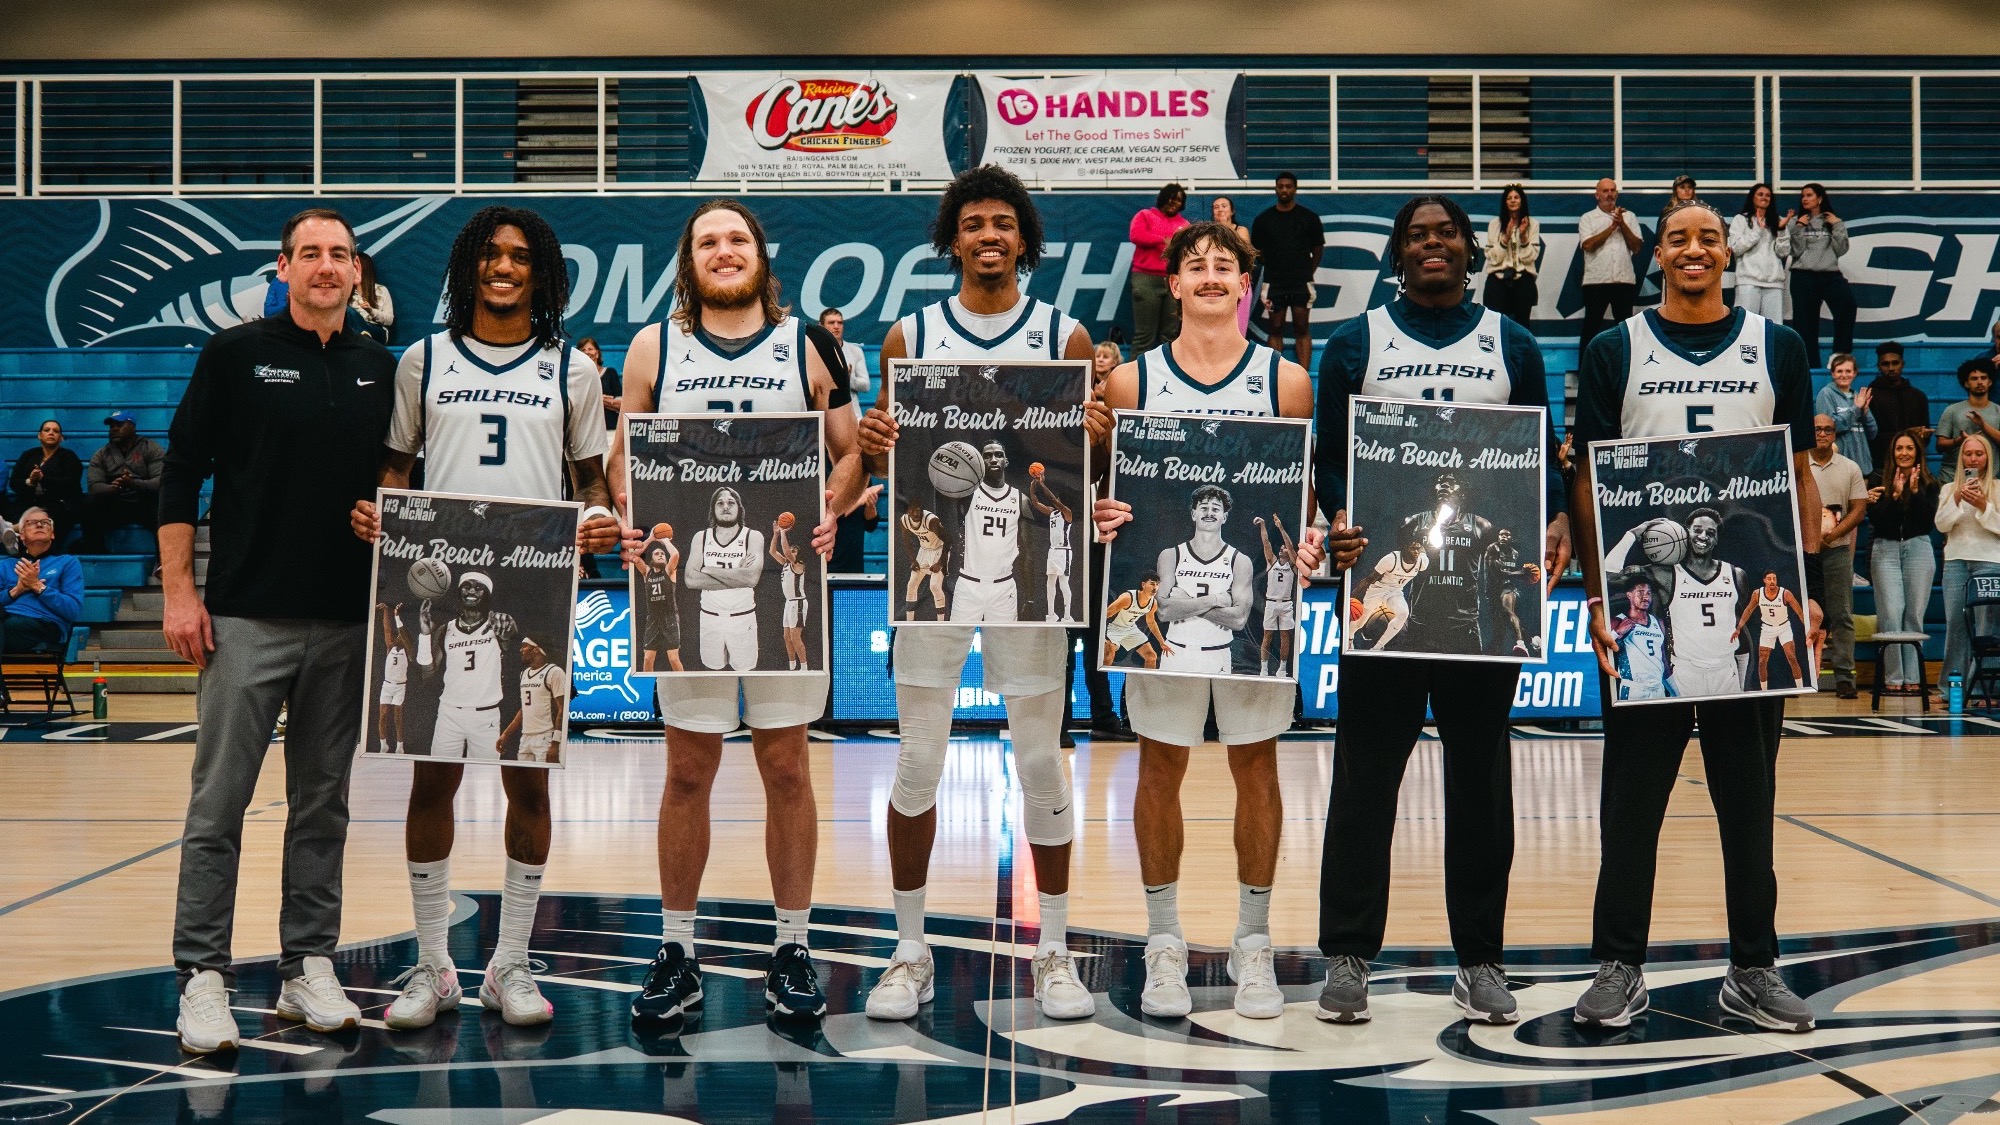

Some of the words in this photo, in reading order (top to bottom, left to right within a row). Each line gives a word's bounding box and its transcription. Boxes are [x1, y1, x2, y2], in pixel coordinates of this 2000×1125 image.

[804, 82, 855, 98] Raising
[1001, 95, 1036, 120] 16
[1045, 89, 1210, 118] HANDLES
[752, 78, 897, 150] Cane's
[800, 137, 840, 145] CHICKEN
[843, 136, 882, 145] FINGERS
[1025, 130, 1045, 141] Let
[1047, 129, 1070, 141] The
[1073, 129, 1108, 141] Good
[1112, 128, 1150, 140] Times
[993, 146, 1032, 154] FROZEN
[1074, 146, 1089, 154] ICE
[1129, 145, 1160, 153] VEGAN
[1163, 145, 1188, 153] SOFT
[1189, 145, 1221, 153] SERVE
[1179, 155, 1207, 163] 33405
[911, 365, 960, 380] Broderick
[1377, 363, 1496, 381] SAILFISH
[675, 375, 787, 392] SAILFISH
[925, 376, 946, 389] Ellis
[1638, 380, 1759, 395] SAILFISH
[437, 389, 552, 409] SAILFISH
[1380, 402, 1405, 416] Alvin
[942, 405, 1007, 431] Beach
[1013, 403, 1087, 431] Atlanti
[1142, 416, 1180, 431] Preston
[1366, 412, 1403, 427] Tumblin
[1404, 415, 1419, 427] Jr.
[630, 422, 647, 437] #21
[648, 419, 679, 434] Jakob
[1119, 419, 1134, 434] #2
[479, 413, 507, 466] 3
[648, 431, 681, 443] Hester
[1134, 429, 1145, 443] Le
[1147, 431, 1188, 443] Gassick
[1400, 441, 1464, 468] Beach
[1469, 447, 1539, 470] Atlanti
[1612, 443, 1649, 458] Jamaal
[934, 452, 960, 471] NCAA
[1597, 451, 1612, 466] #5
[1614, 455, 1649, 469] Walker
[678, 458, 743, 482] Beach
[748, 455, 820, 482] Atlanti
[1163, 456, 1226, 483] Beach
[1233, 461, 1304, 485] Atlanti
[1646, 481, 1713, 506] Beach
[1718, 470, 1789, 501] Atlanti
[383, 499, 400, 514] #3
[406, 496, 432, 509] Trent
[975, 504, 1017, 516] SAILFISH
[398, 507, 437, 522] McNair
[983, 515, 1008, 538] 24
[1445, 536, 1471, 547] BEACH
[429, 538, 496, 567] Beach
[500, 545, 577, 569] Atlanti
[705, 551, 744, 559] SAILFISH
[1439, 549, 1454, 571] 11
[1177, 570, 1231, 580] SAILFISH
[1278, 572, 1284, 582] 2
[1428, 576, 1464, 587] ATLANTIC
[652, 583, 662, 596] 21
[1679, 591, 1733, 599] SAILFISH
[1701, 603, 1716, 626] 5
[1769, 608, 1775, 617] 5
[448, 637, 492, 650] SAILFISH
[1646, 639, 1655, 656] 5
[393, 656, 399, 666] 3
[464, 650, 475, 671] 3
[525, 690, 531, 706] 3
[620, 711, 649, 721] (800)
